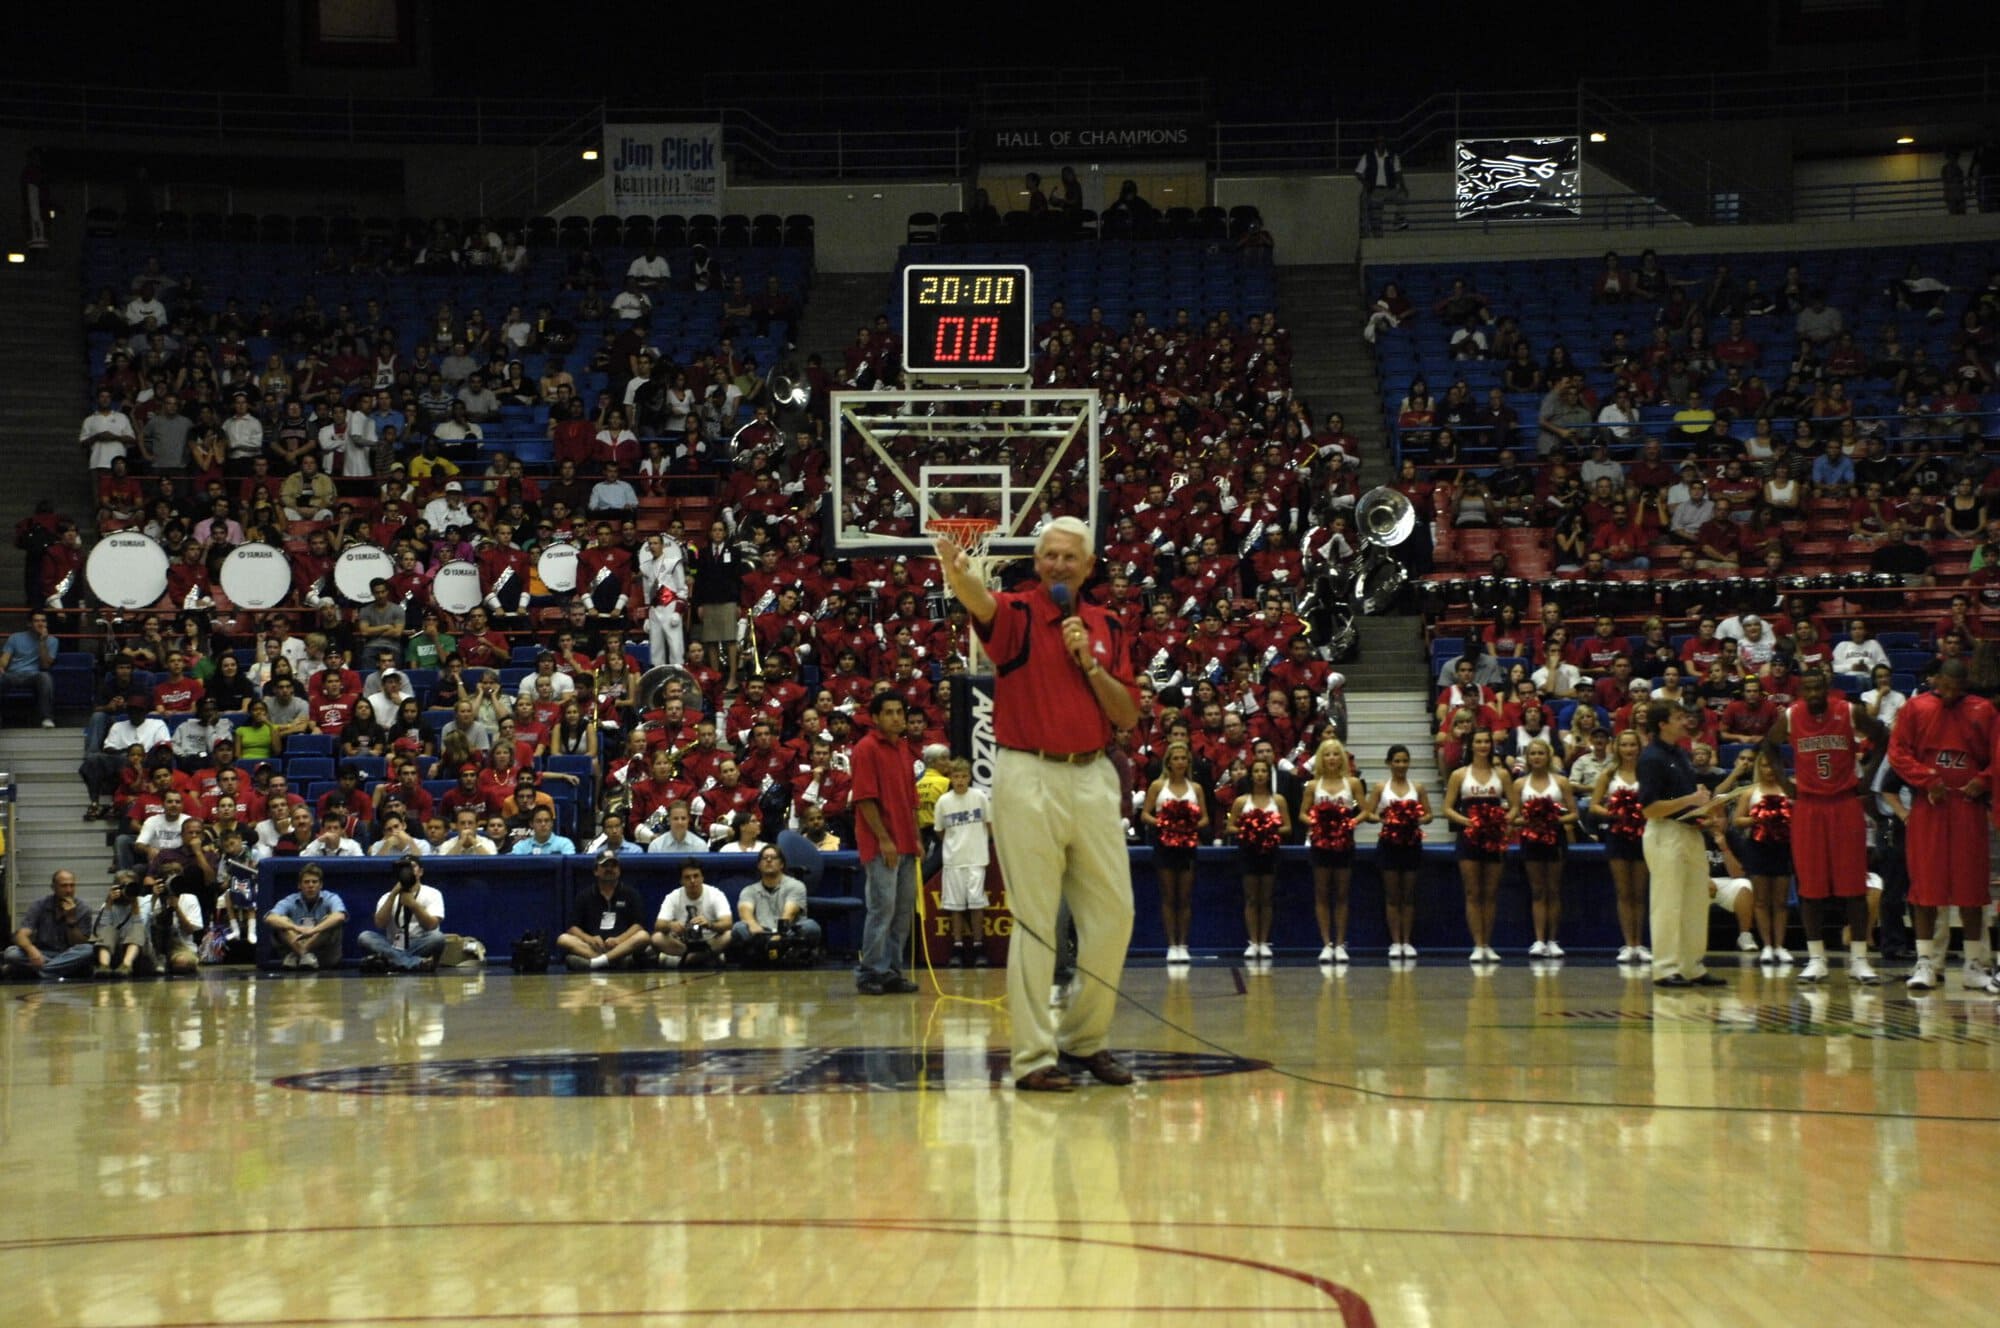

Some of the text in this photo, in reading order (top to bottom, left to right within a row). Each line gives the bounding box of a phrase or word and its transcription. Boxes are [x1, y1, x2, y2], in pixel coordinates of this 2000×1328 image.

[996, 128, 1188, 147] HALL OF CHAMPIONS
[613, 137, 714, 171] Jim Click
[919, 276, 1015, 304] 20:00
[933, 315, 1000, 362] 00
[247, 551, 273, 559] YAMAHA
[355, 552, 380, 560] YAMAHA
[452, 569, 477, 577] YAMAHA
[971, 686, 997, 799] ARIZO
[1816, 753, 1831, 780] 5
[1935, 751, 1969, 769] 42
